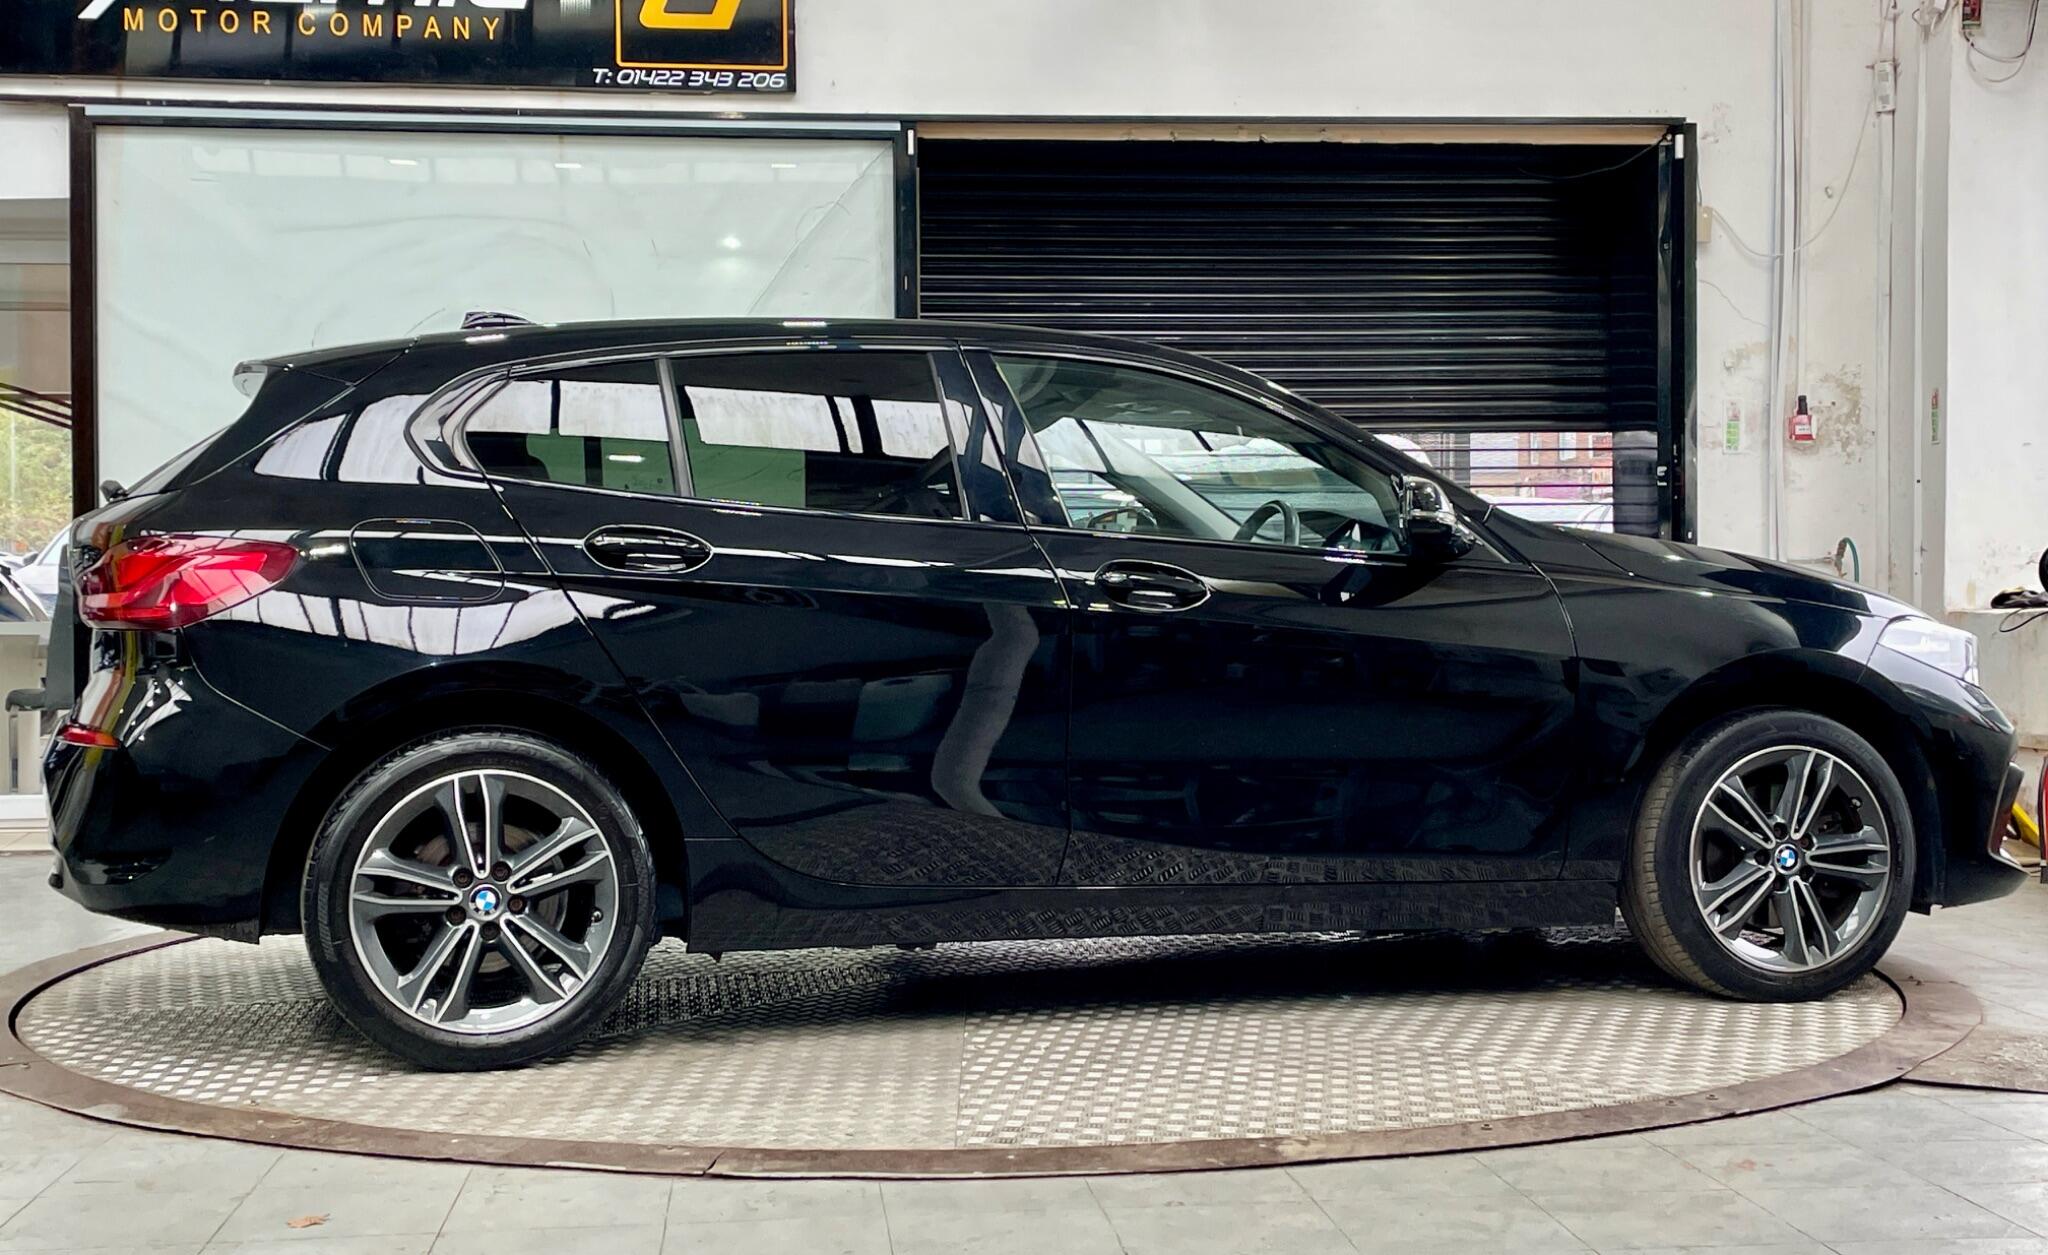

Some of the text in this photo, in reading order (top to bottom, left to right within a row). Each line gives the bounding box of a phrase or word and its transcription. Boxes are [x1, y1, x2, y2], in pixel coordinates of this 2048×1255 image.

[123, 7, 272, 34] MOTOR
[298, 12, 501, 41] COMPANY
[592, 68, 787, 88] T: 01422 343 206
